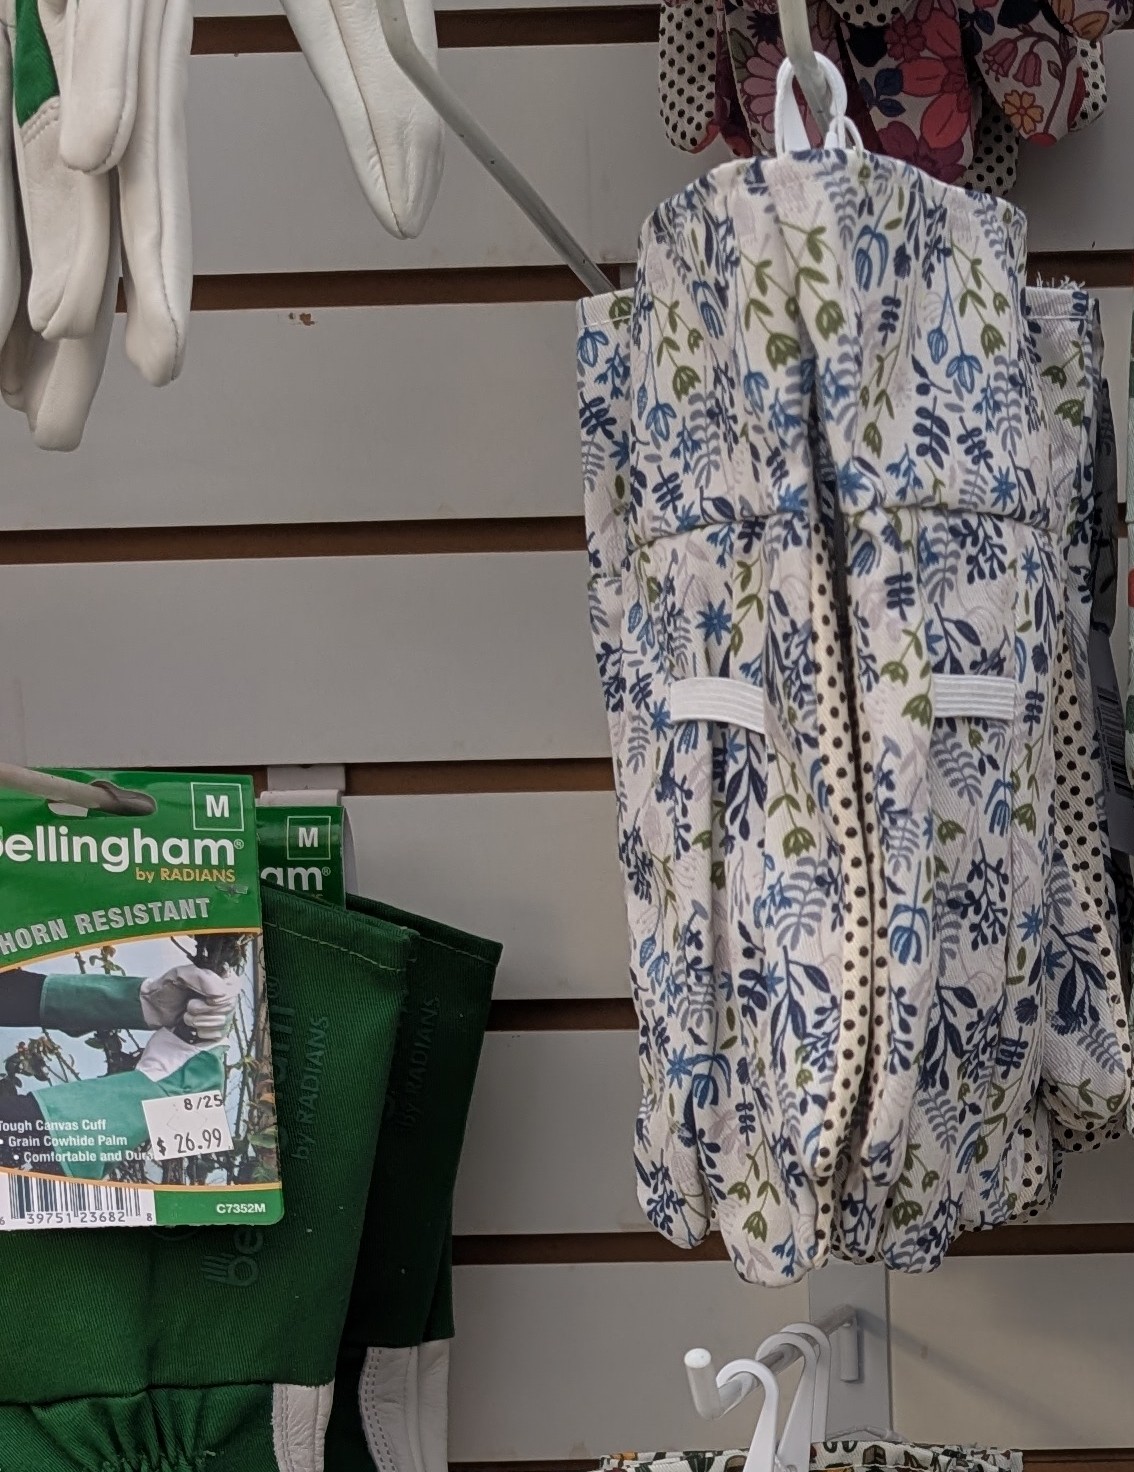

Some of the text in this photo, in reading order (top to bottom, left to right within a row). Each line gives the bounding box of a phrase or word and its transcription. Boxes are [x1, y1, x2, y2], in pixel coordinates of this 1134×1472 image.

[205, 794, 230, 818] M
[298, 827, 319, 848] M
[0, 825, 235, 874] ellingham
[135, 867, 236, 884] by RADIANS
[0, 897, 210, 955] HORN RESISTANT
[295, 1015, 331, 1125] RADIANS
[183, 1093, 223, 1111] 8/25
[35, 1119, 79, 1131] Canvas
[82, 1118, 107, 1131] Cuff
[8, 1134, 128, 1147] Grain Cowhide Palm
[174, 1127, 222, 1155] 26.99
[23, 1149, 156, 1163] Comfortable and Dura
[215, 1202, 267, 1214] C7352M
[27, 1211, 72, 1225] 39751
[80, 1210, 126, 1223] 23682
[146, 1212, 153, 1222] 8
